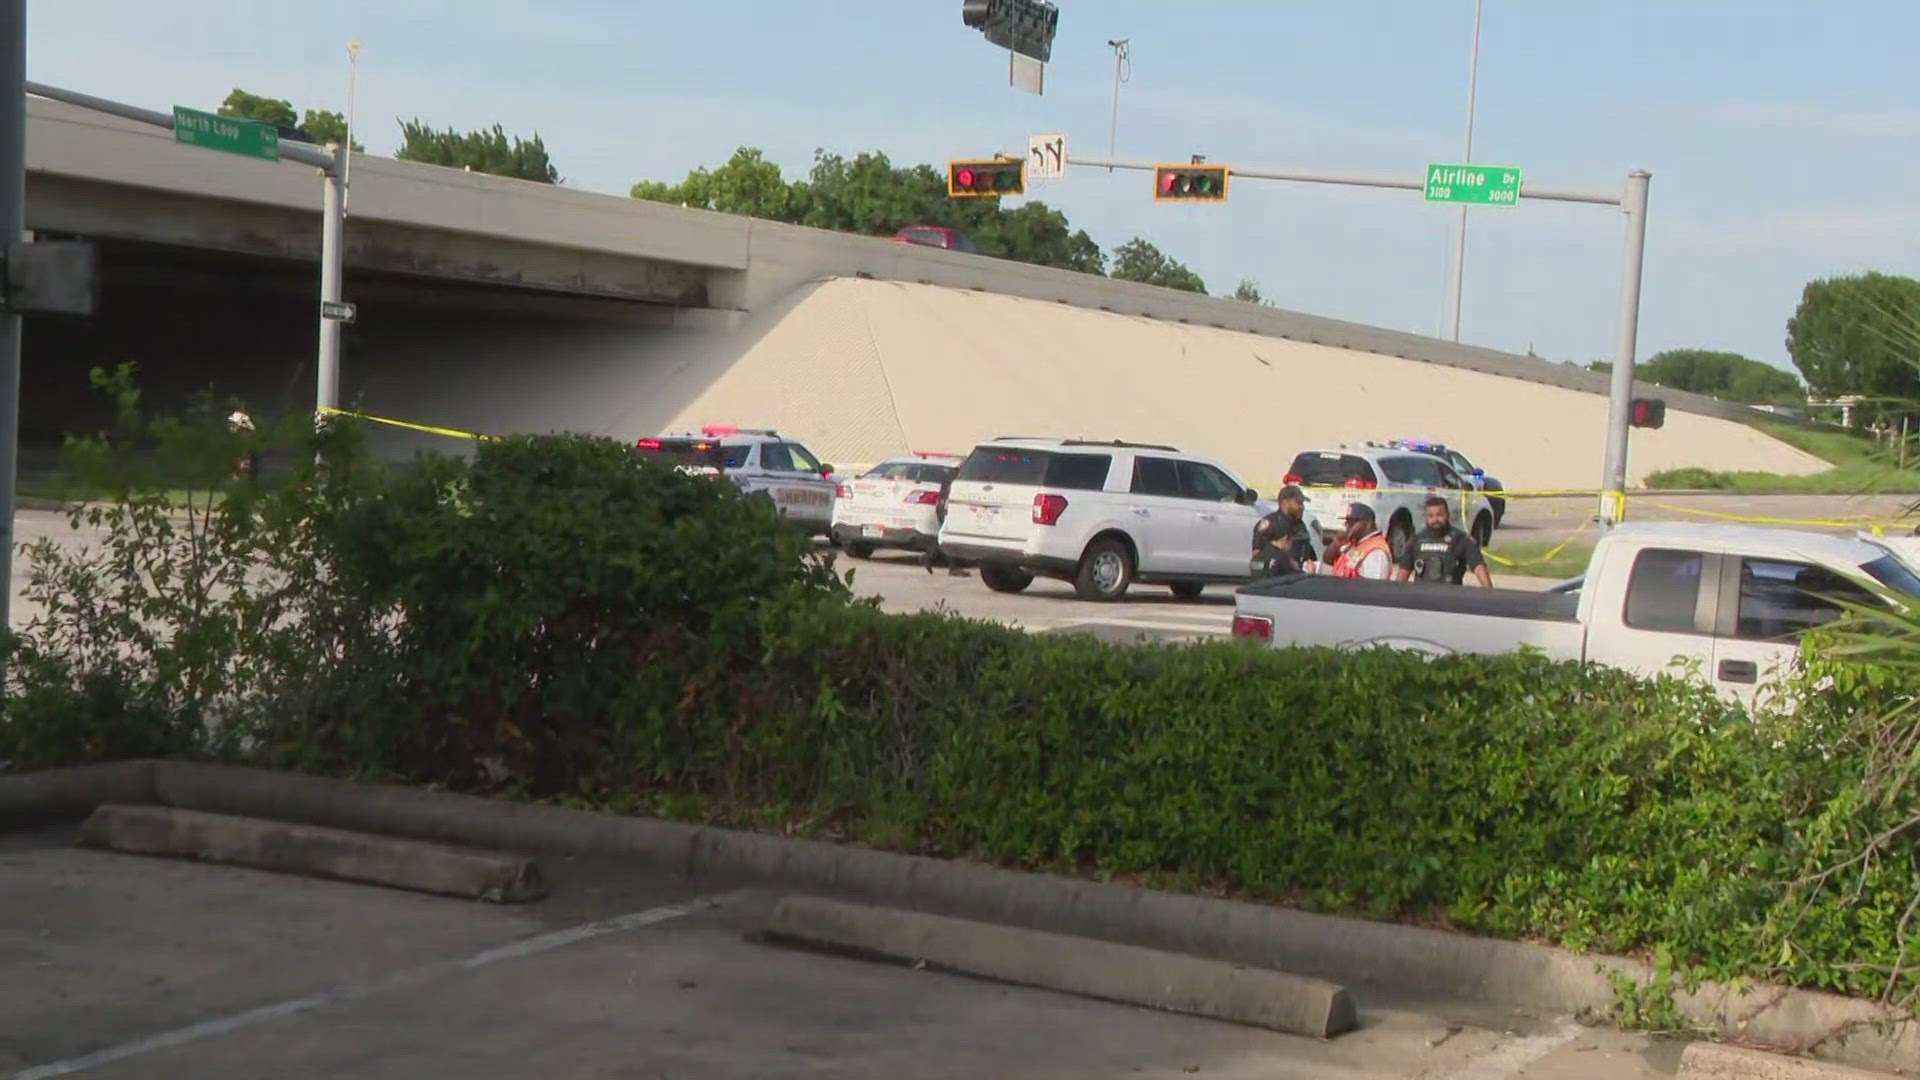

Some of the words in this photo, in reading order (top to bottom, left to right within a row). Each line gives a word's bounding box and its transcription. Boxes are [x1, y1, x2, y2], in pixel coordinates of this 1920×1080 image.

[177, 112, 210, 133] North
[213, 119, 239, 141] Loop
[1430, 168, 1485, 186] Airline
[1503, 173, 1516, 184] Dr
[1428, 186, 1451, 198] 3100
[1488, 190, 1514, 201] 3000
